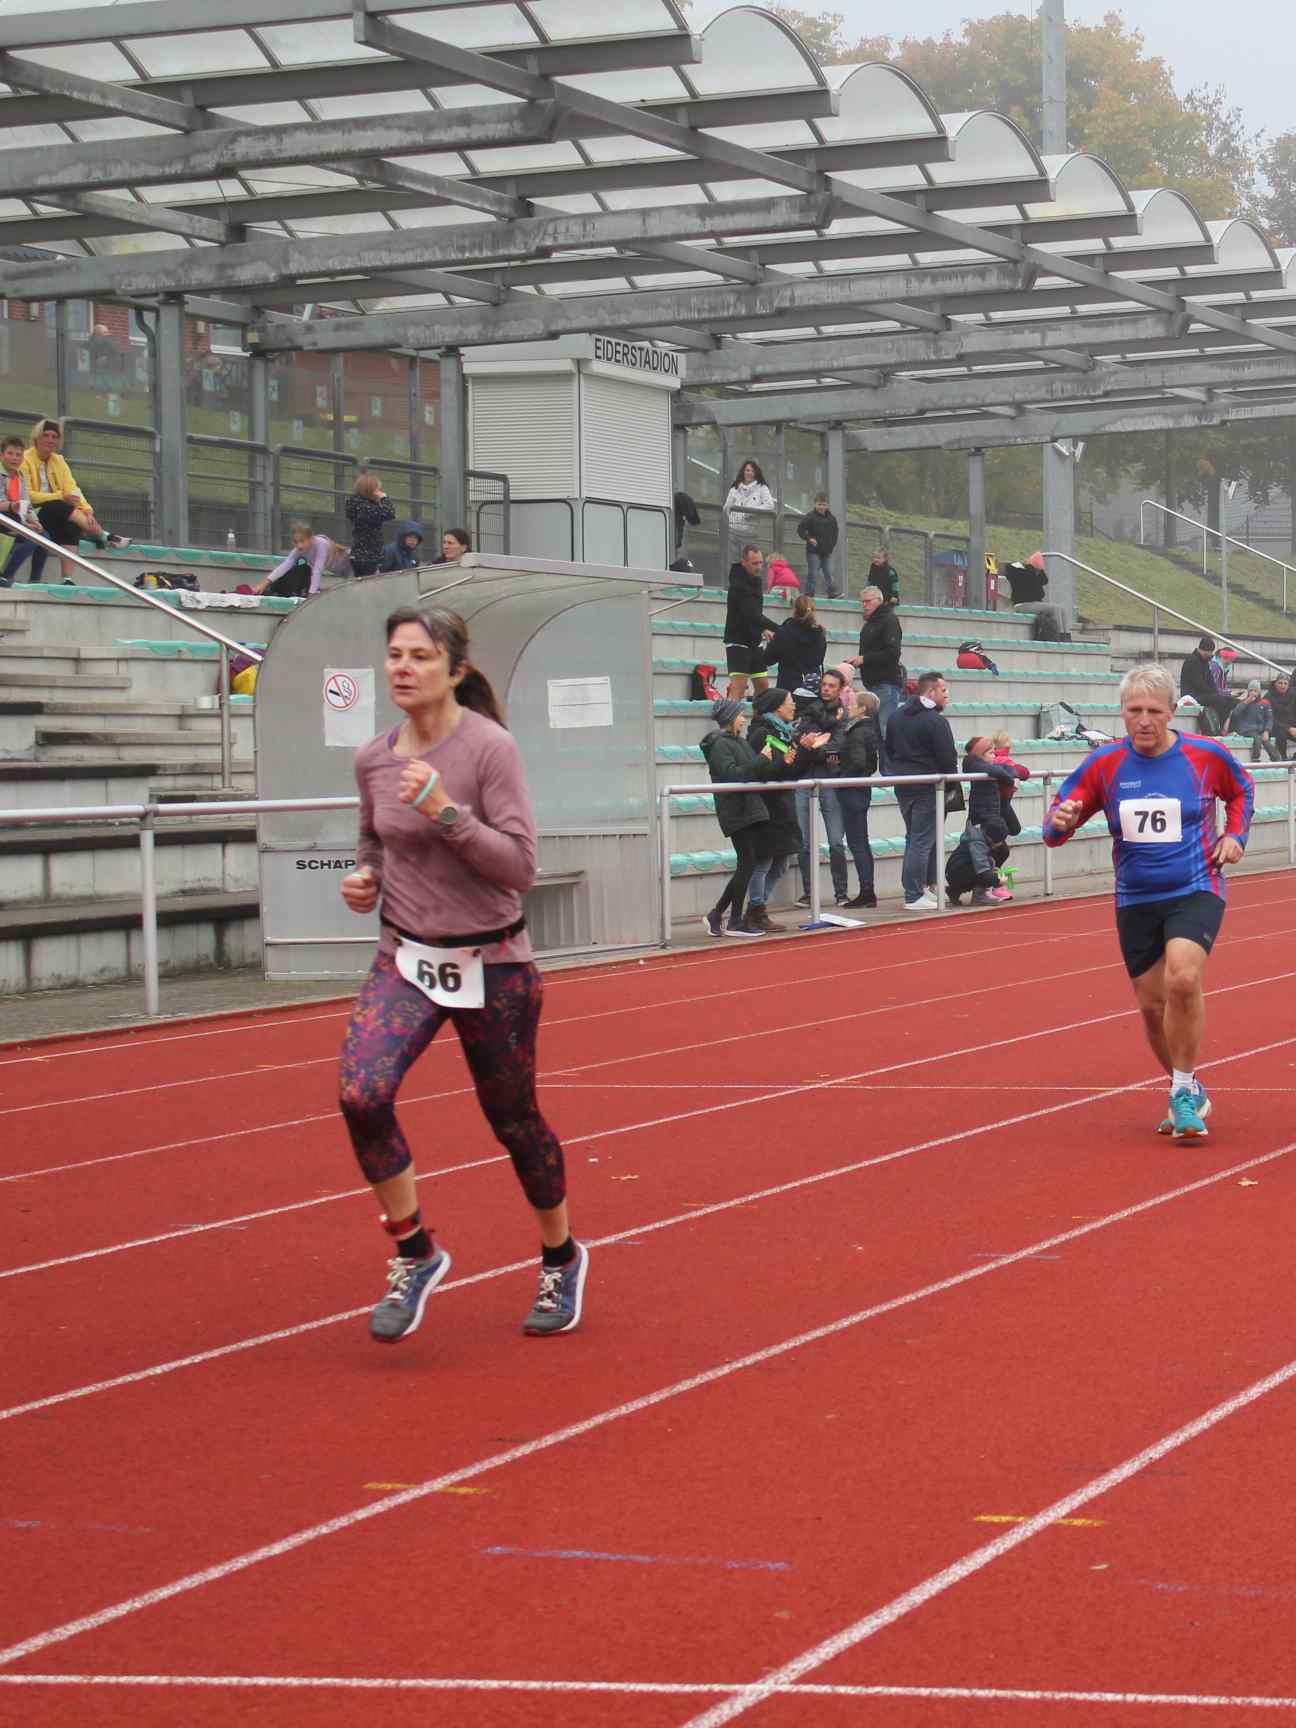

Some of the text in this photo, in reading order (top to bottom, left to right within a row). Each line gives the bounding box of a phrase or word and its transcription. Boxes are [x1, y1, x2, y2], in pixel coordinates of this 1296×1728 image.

[594, 338, 679, 376] EIDERSTADION
[1134, 810, 1167, 834] 76
[416, 959, 462, 993] 66
